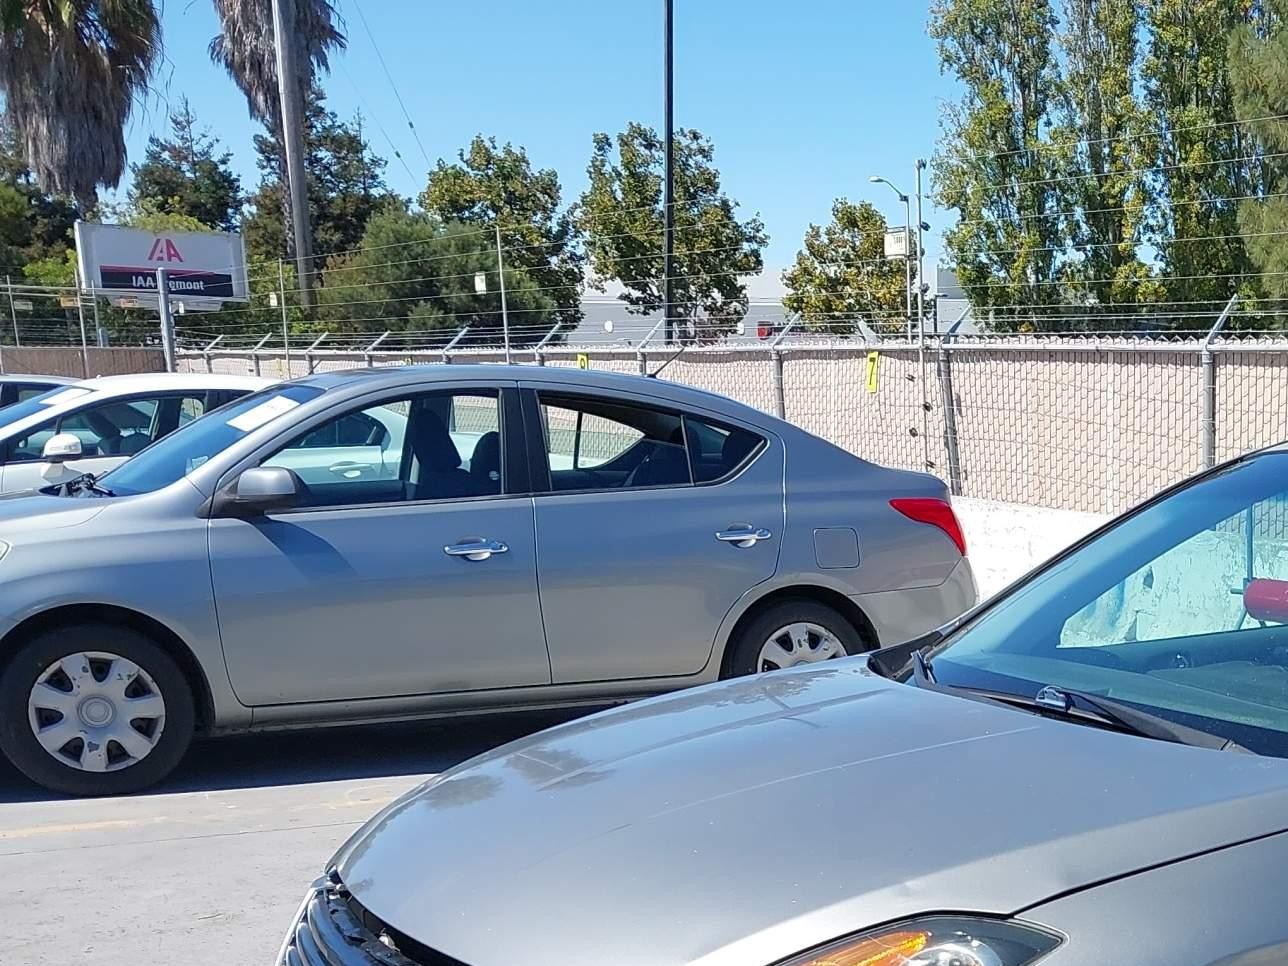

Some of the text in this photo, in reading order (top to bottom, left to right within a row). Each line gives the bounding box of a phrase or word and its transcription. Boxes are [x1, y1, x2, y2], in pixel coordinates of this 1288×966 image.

[132, 275, 204, 291] IAA emont
[869, 357, 876, 385] 7
